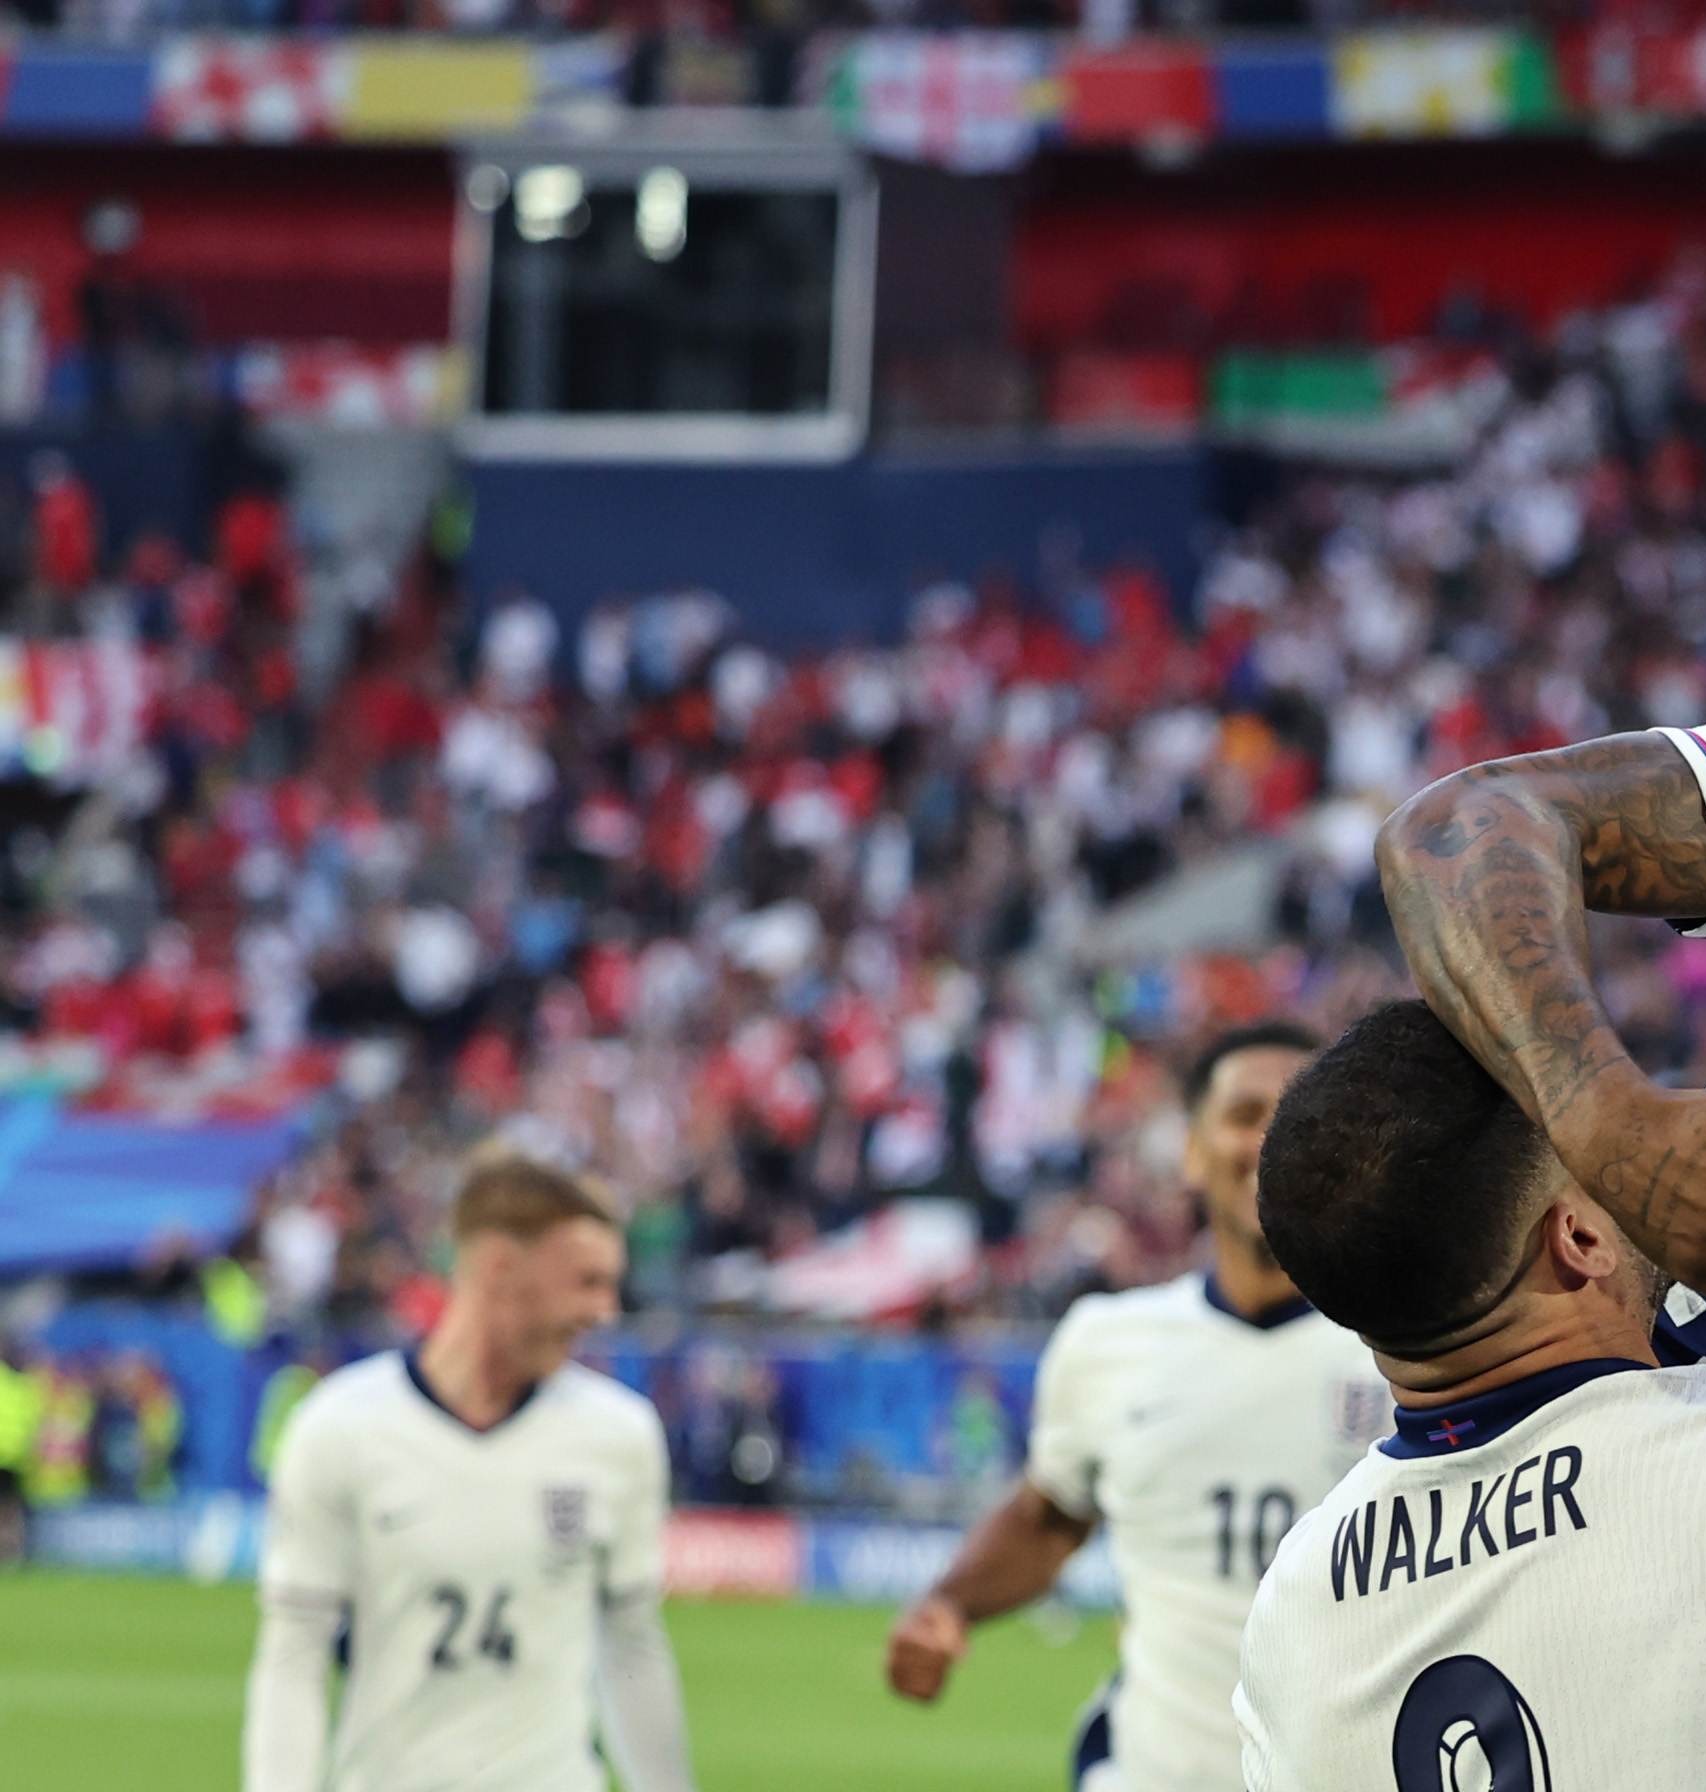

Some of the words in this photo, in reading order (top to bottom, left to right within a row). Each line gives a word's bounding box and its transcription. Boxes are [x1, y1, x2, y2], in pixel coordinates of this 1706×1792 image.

[1206, 1485, 1296, 1580] 10
[1330, 1444, 1588, 1602] WALKER
[430, 1585, 516, 1670] 24
